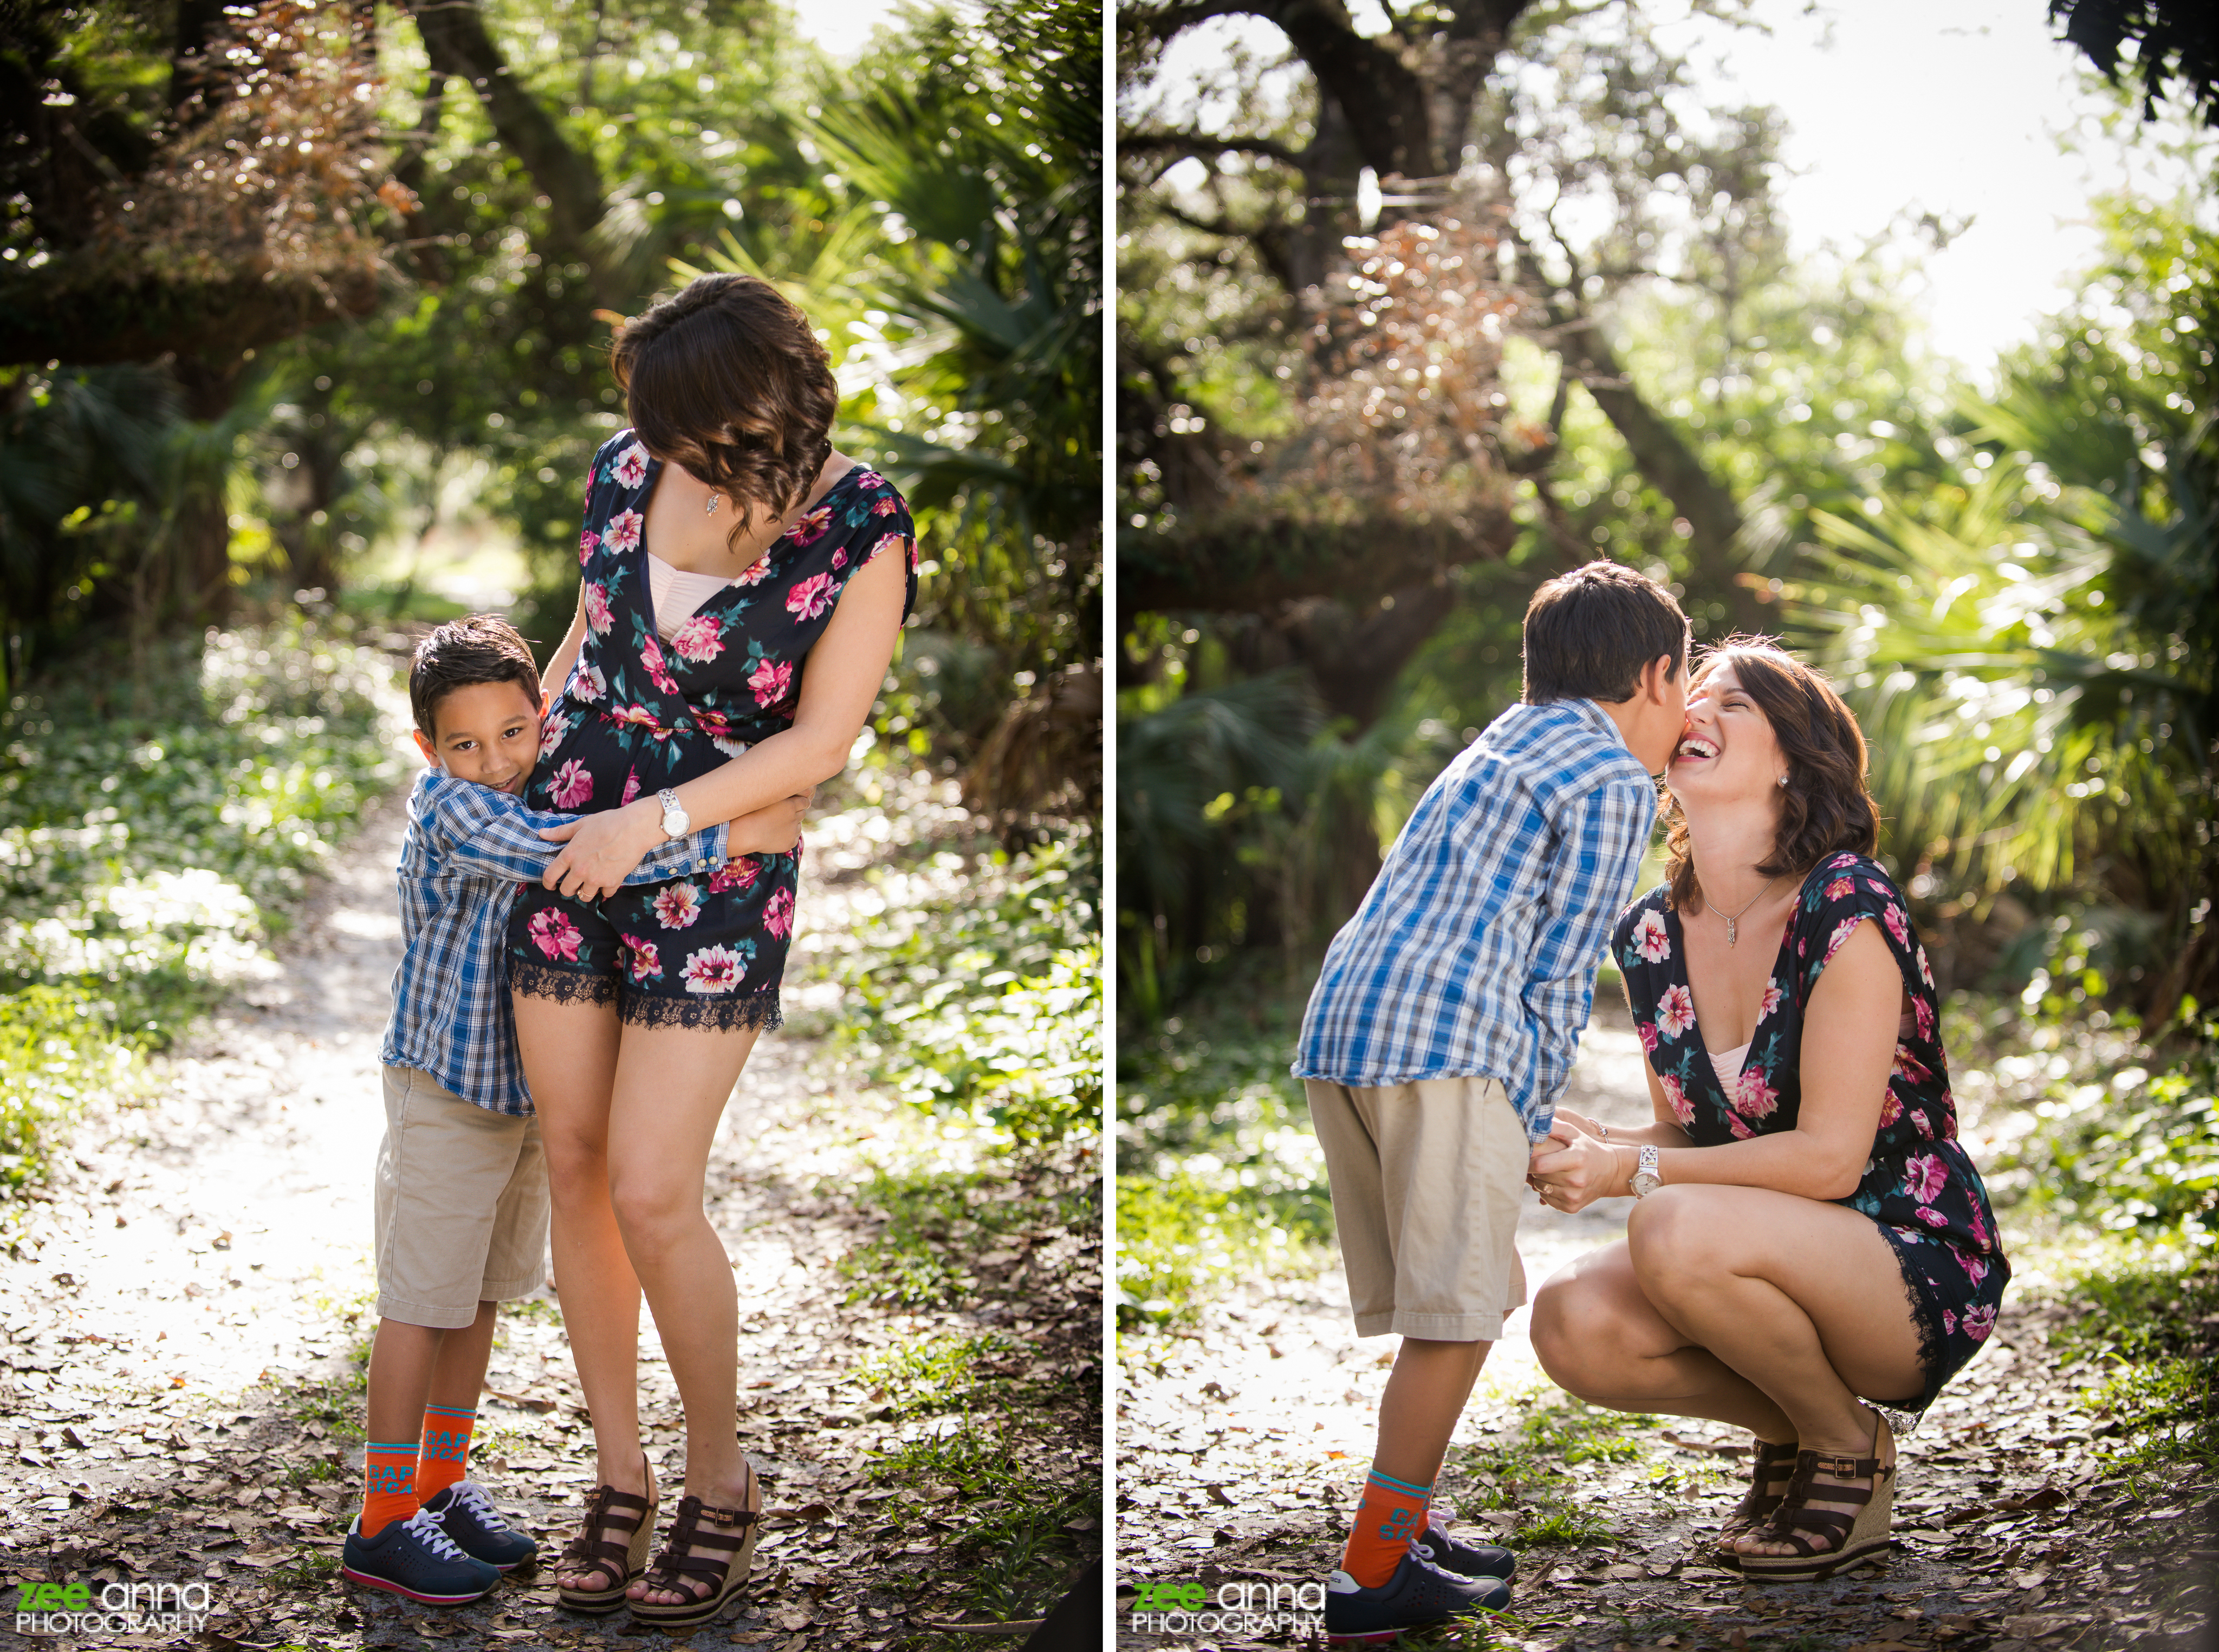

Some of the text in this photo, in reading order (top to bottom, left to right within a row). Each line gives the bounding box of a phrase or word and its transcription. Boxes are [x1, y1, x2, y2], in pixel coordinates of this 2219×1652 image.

[425, 1430, 470, 1449] GAP
[423, 1446, 465, 1464] SFCA
[368, 1464, 414, 1481] GAP
[367, 1480, 412, 1495] SFCA
[1390, 1507, 1420, 1527] GA
[1379, 1524, 1415, 1543] SFC
